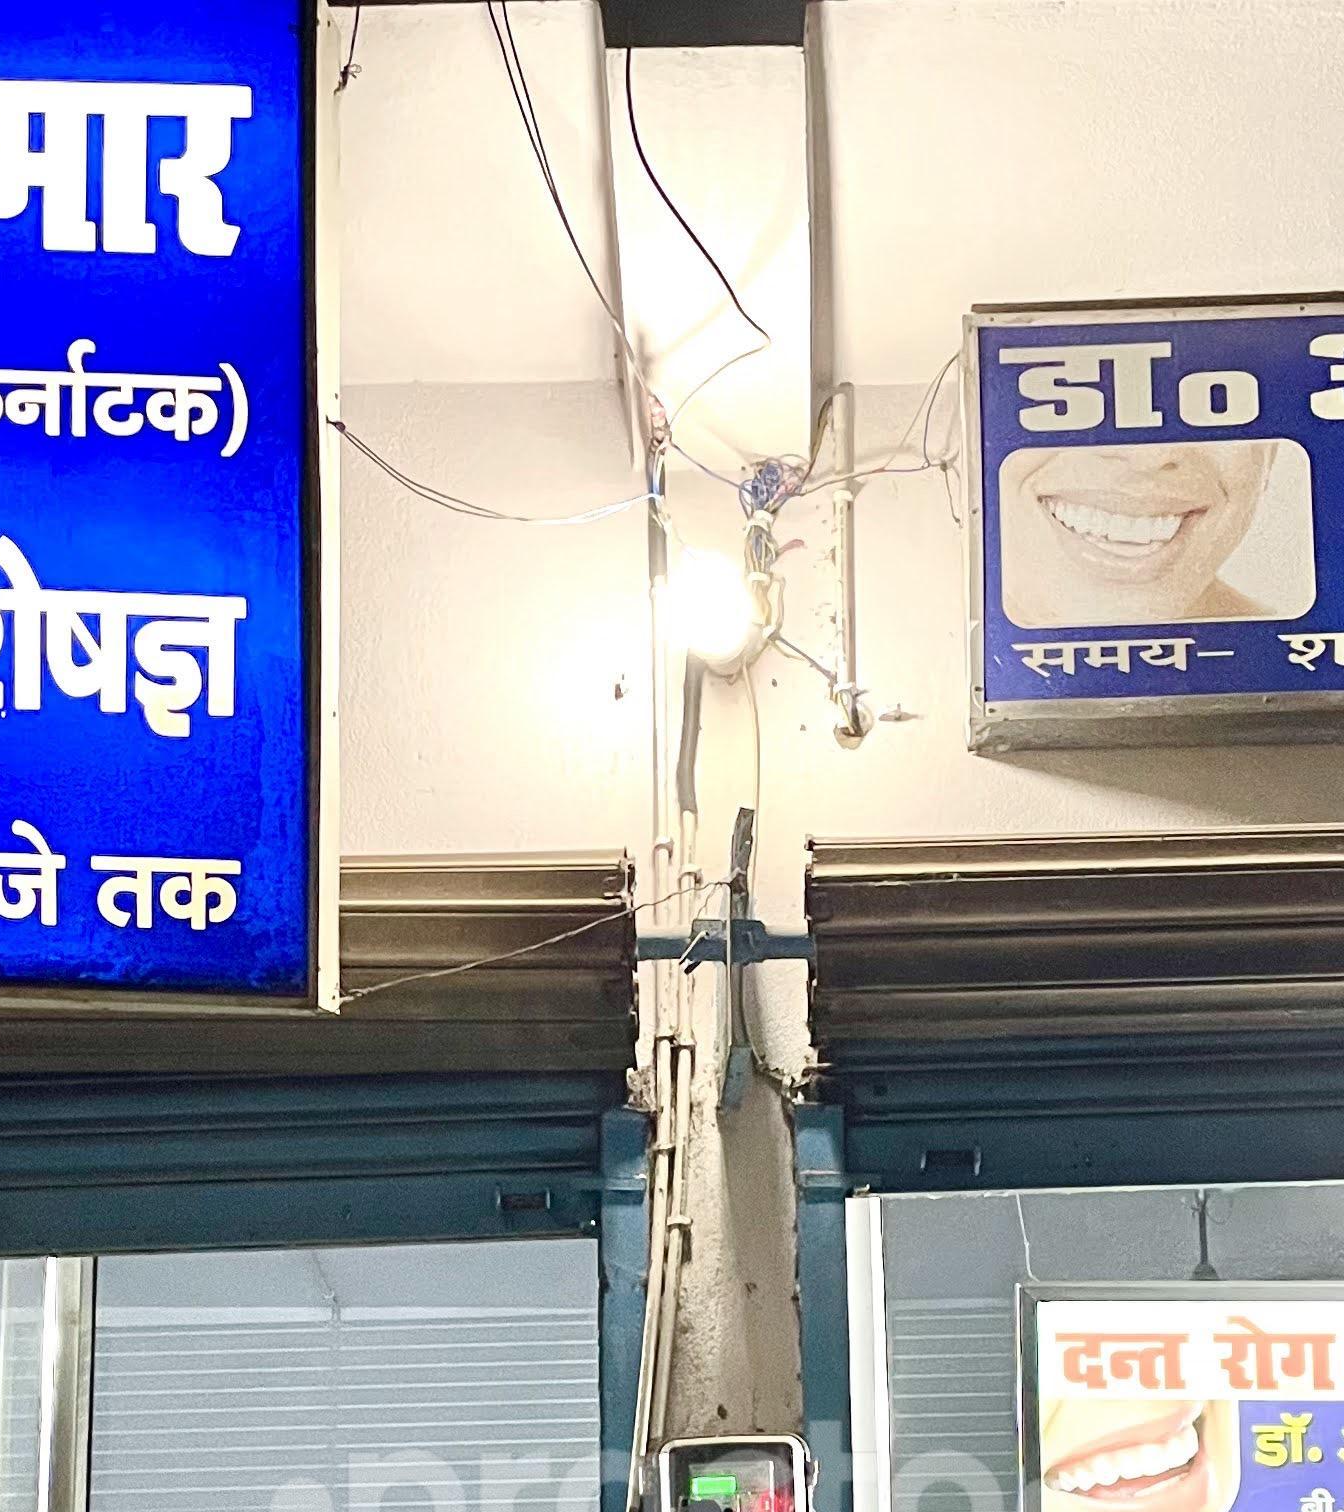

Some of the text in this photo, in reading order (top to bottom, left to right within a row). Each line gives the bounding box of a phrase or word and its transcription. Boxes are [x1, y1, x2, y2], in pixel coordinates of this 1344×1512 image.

[90, 855, 242, 931] तक
[1055, 1333, 1189, 1391] दन्त
[1213, 1315, 1336, 1391] रोग
[1251, 1412, 1324, 1468] डॉ.
